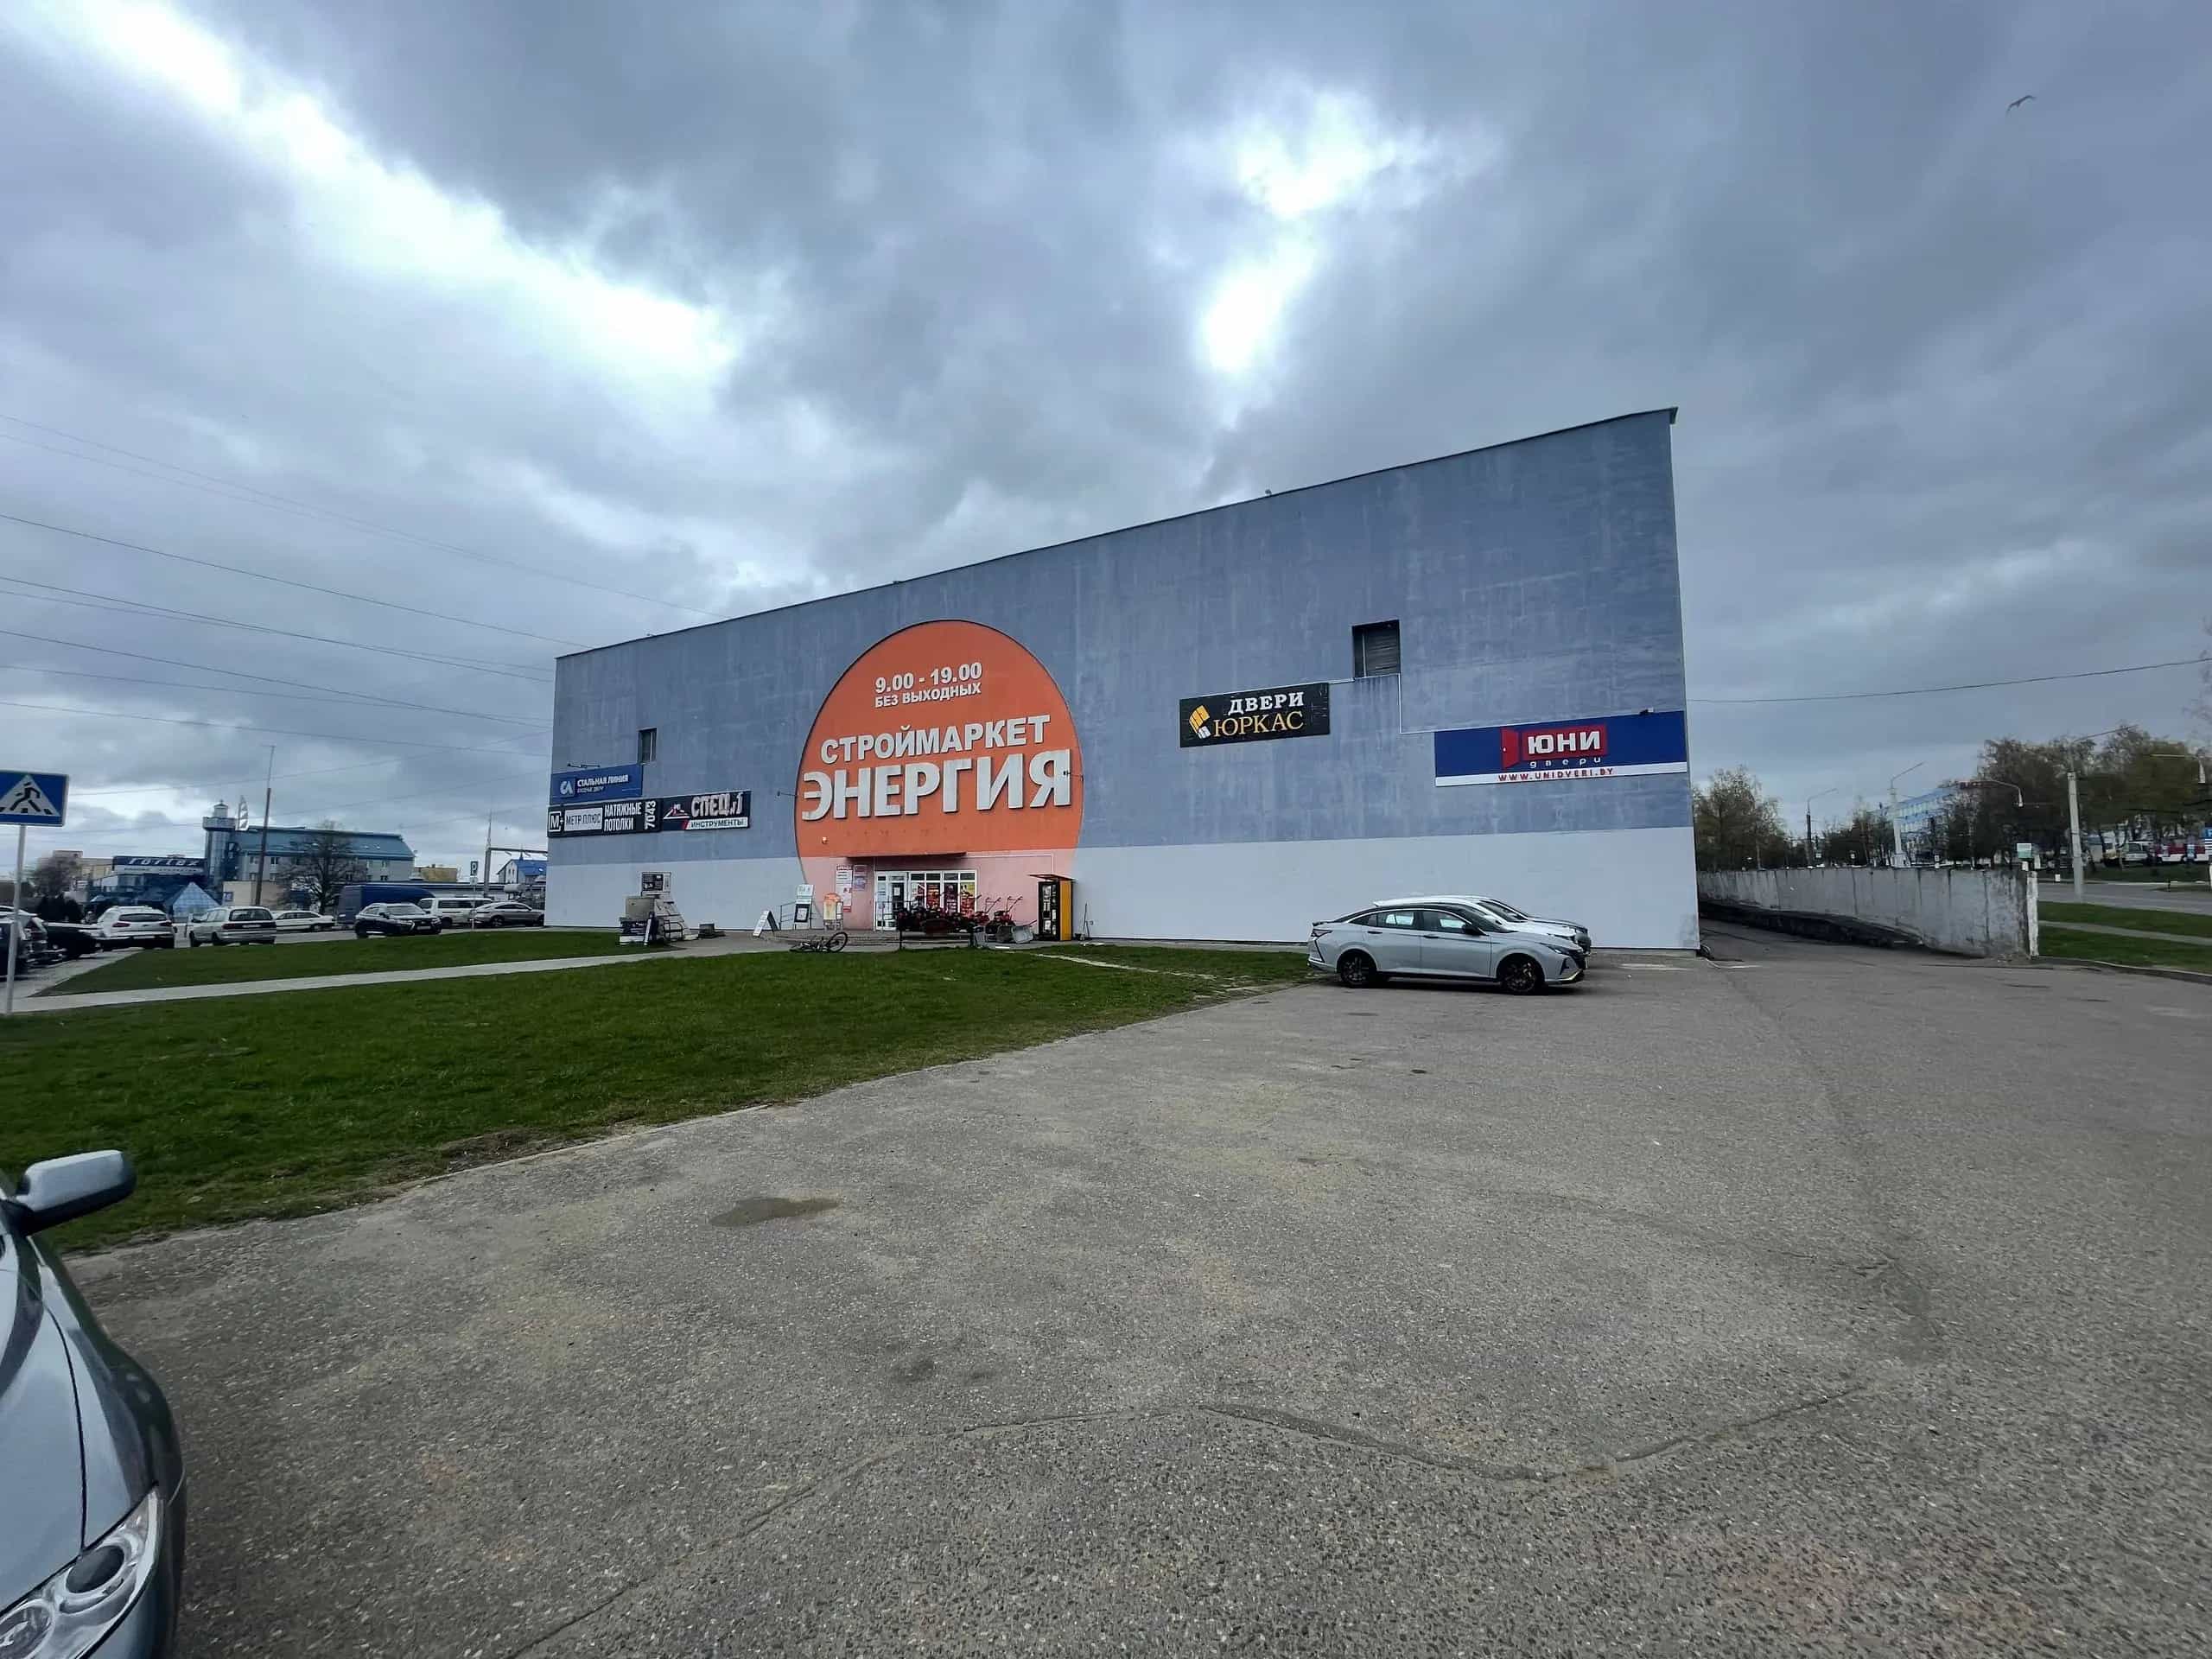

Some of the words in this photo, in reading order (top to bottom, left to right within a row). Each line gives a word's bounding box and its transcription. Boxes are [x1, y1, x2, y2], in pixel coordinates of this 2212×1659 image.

[874, 672, 914, 693] 9.00
[930, 662, 982, 685] 19.00
[874, 695, 899, 708] БЕЗ
[902, 682, 982, 704] ВЫХОДНЫХ
[1228, 692, 1304, 716] ДВЕРИ
[1213, 710, 1304, 738] ЮРКАС
[820, 715, 1051, 764] СТРОЙМАРКЕТ
[1527, 730, 1601, 754] ЮНИ
[801, 748, 1071, 821] ЭНЕРГИЯ
[1497, 767, 1613, 782] WWW.UNIDVERI.BY
[604, 801, 642, 817] НАТЯЖНЫЕ
[644, 799, 657, 830] 7043
[604, 817, 634, 832] ПОТОЛКИ
[691, 818, 745, 829] ИНСТРУМЕНТЫ
